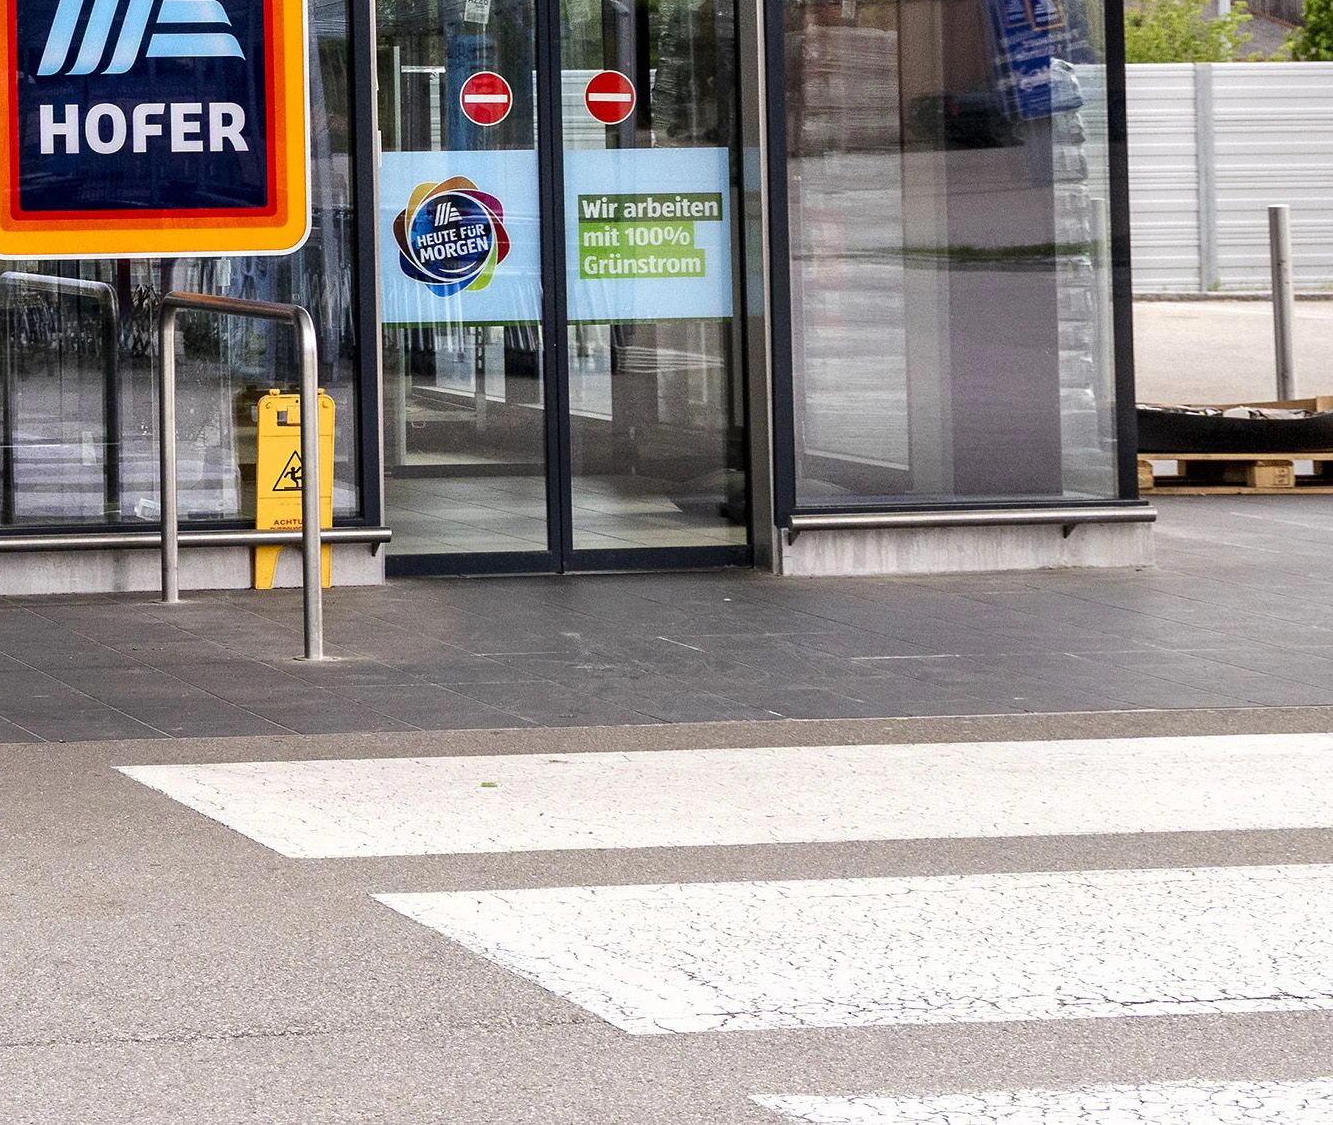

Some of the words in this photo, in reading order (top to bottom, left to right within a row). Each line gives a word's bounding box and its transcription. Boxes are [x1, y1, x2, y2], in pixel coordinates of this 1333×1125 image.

[39, 102, 249, 155] HOFER
[582, 197, 618, 218] Wir
[623, 196, 719, 218] arbeiten
[417, 228, 458, 248] HEUTE
[460, 223, 486, 239] FÜR
[583, 226, 620, 247] mit
[625, 226, 691, 246] 100%
[419, 236, 489, 264] MORGEN
[584, 253, 701, 275] Grünstrom
[274, 518, 303, 526] ACHTU
